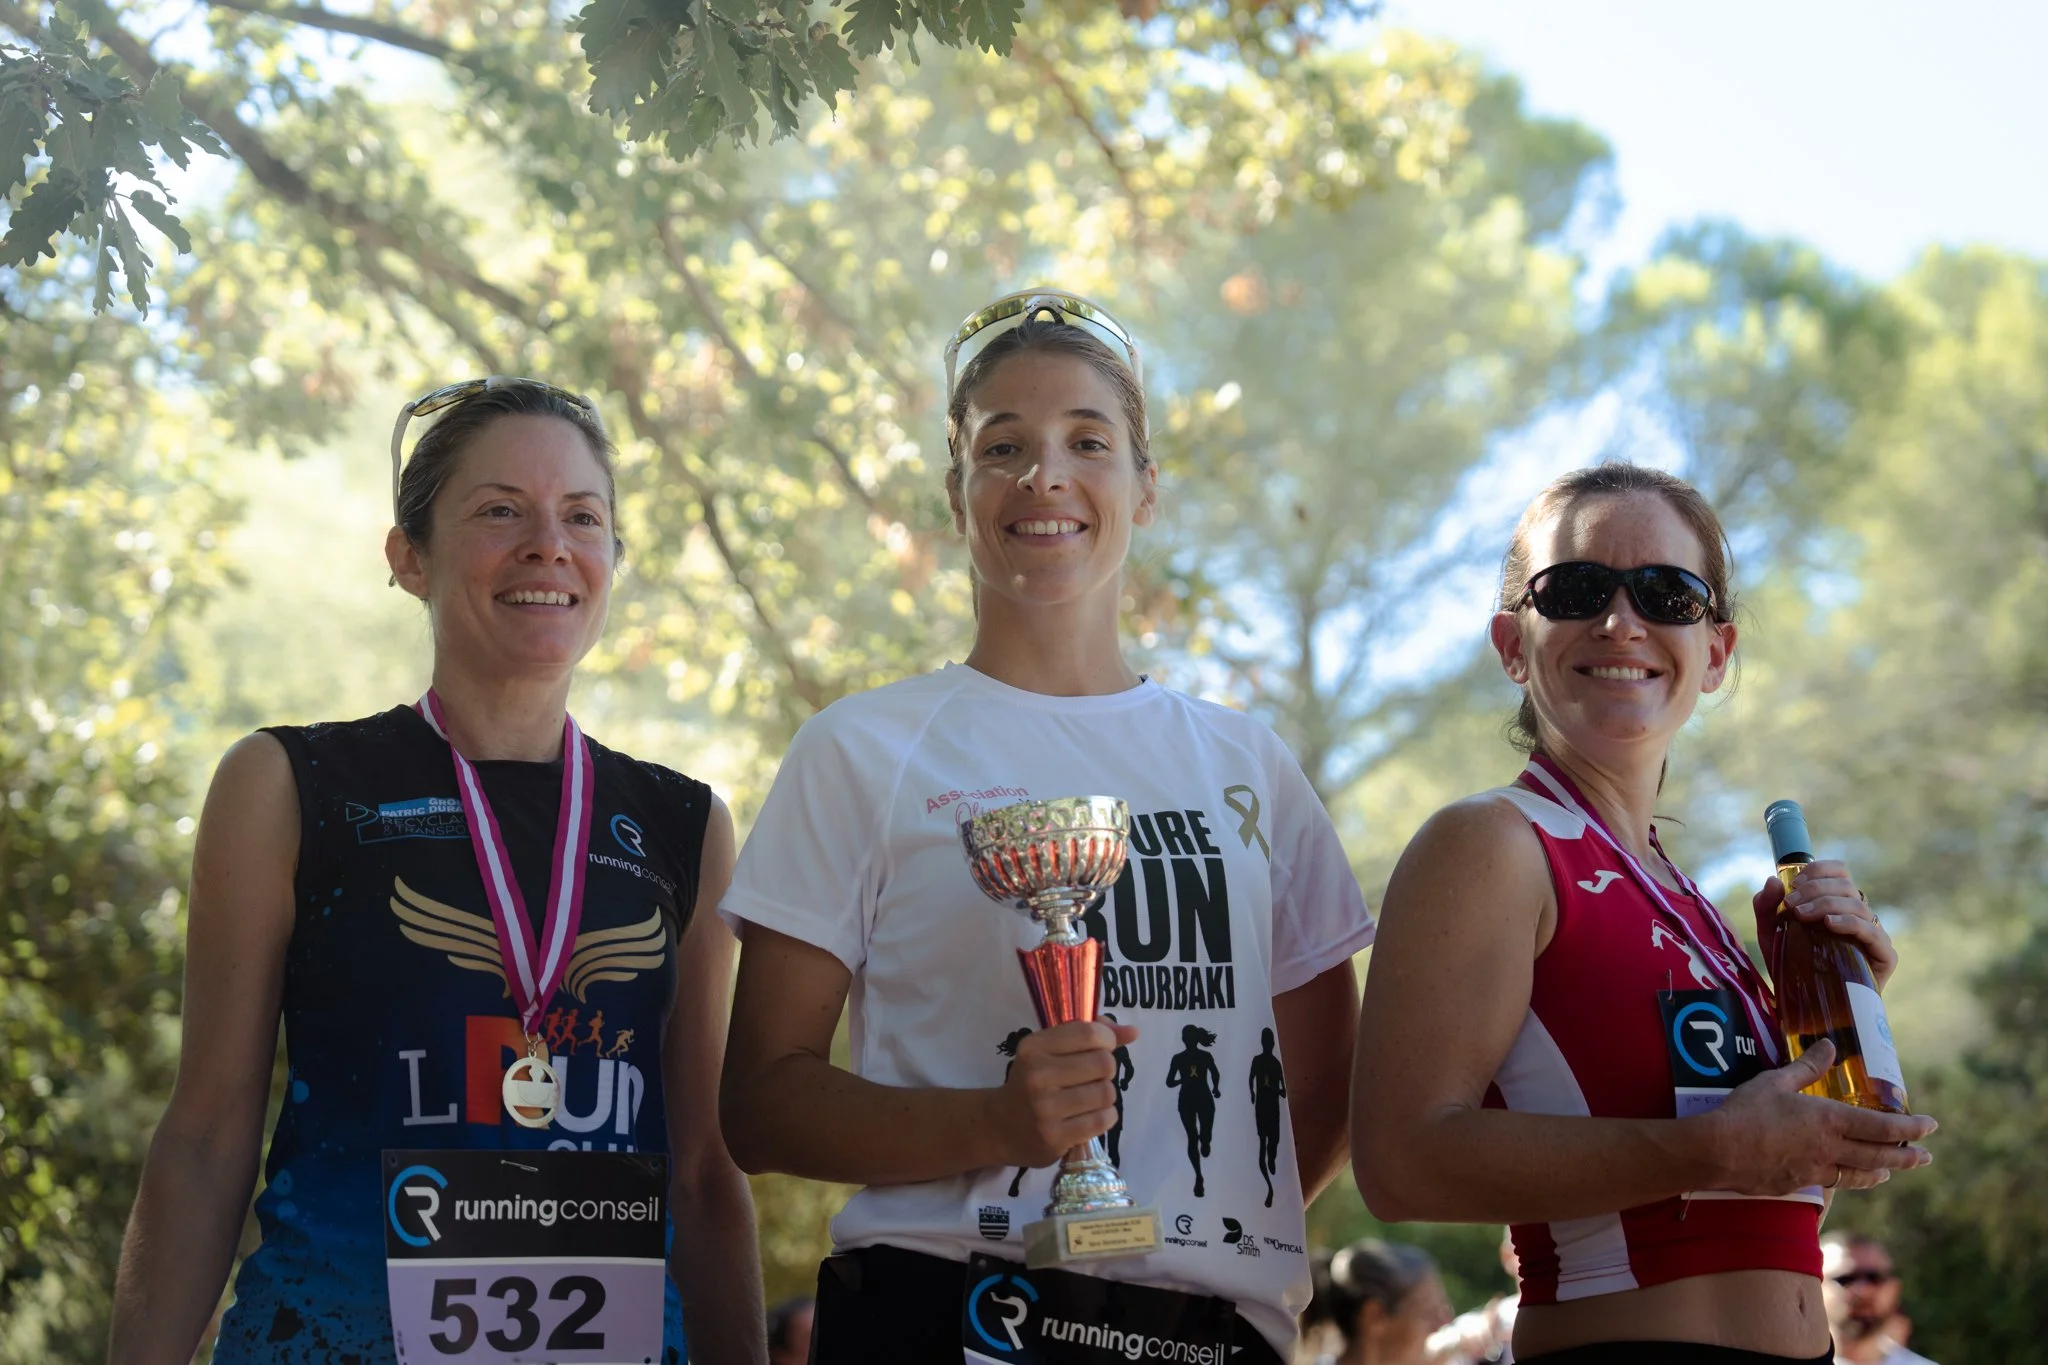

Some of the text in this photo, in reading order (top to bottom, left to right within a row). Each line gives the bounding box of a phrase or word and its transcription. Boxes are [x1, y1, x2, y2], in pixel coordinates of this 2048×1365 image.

[381, 805, 464, 817] PATRIC DURA
[398, 825, 467, 836] TRANSPO
[1102, 965, 1236, 1010] BOURBAKI
[454, 1194, 660, 1226] runningconseil
[1236, 1244, 1261, 1257] Smith
[1243, 1234, 1255, 1246] DS
[428, 1275, 607, 1355] 532
[1041, 1316, 1225, 1365] runningconseil
